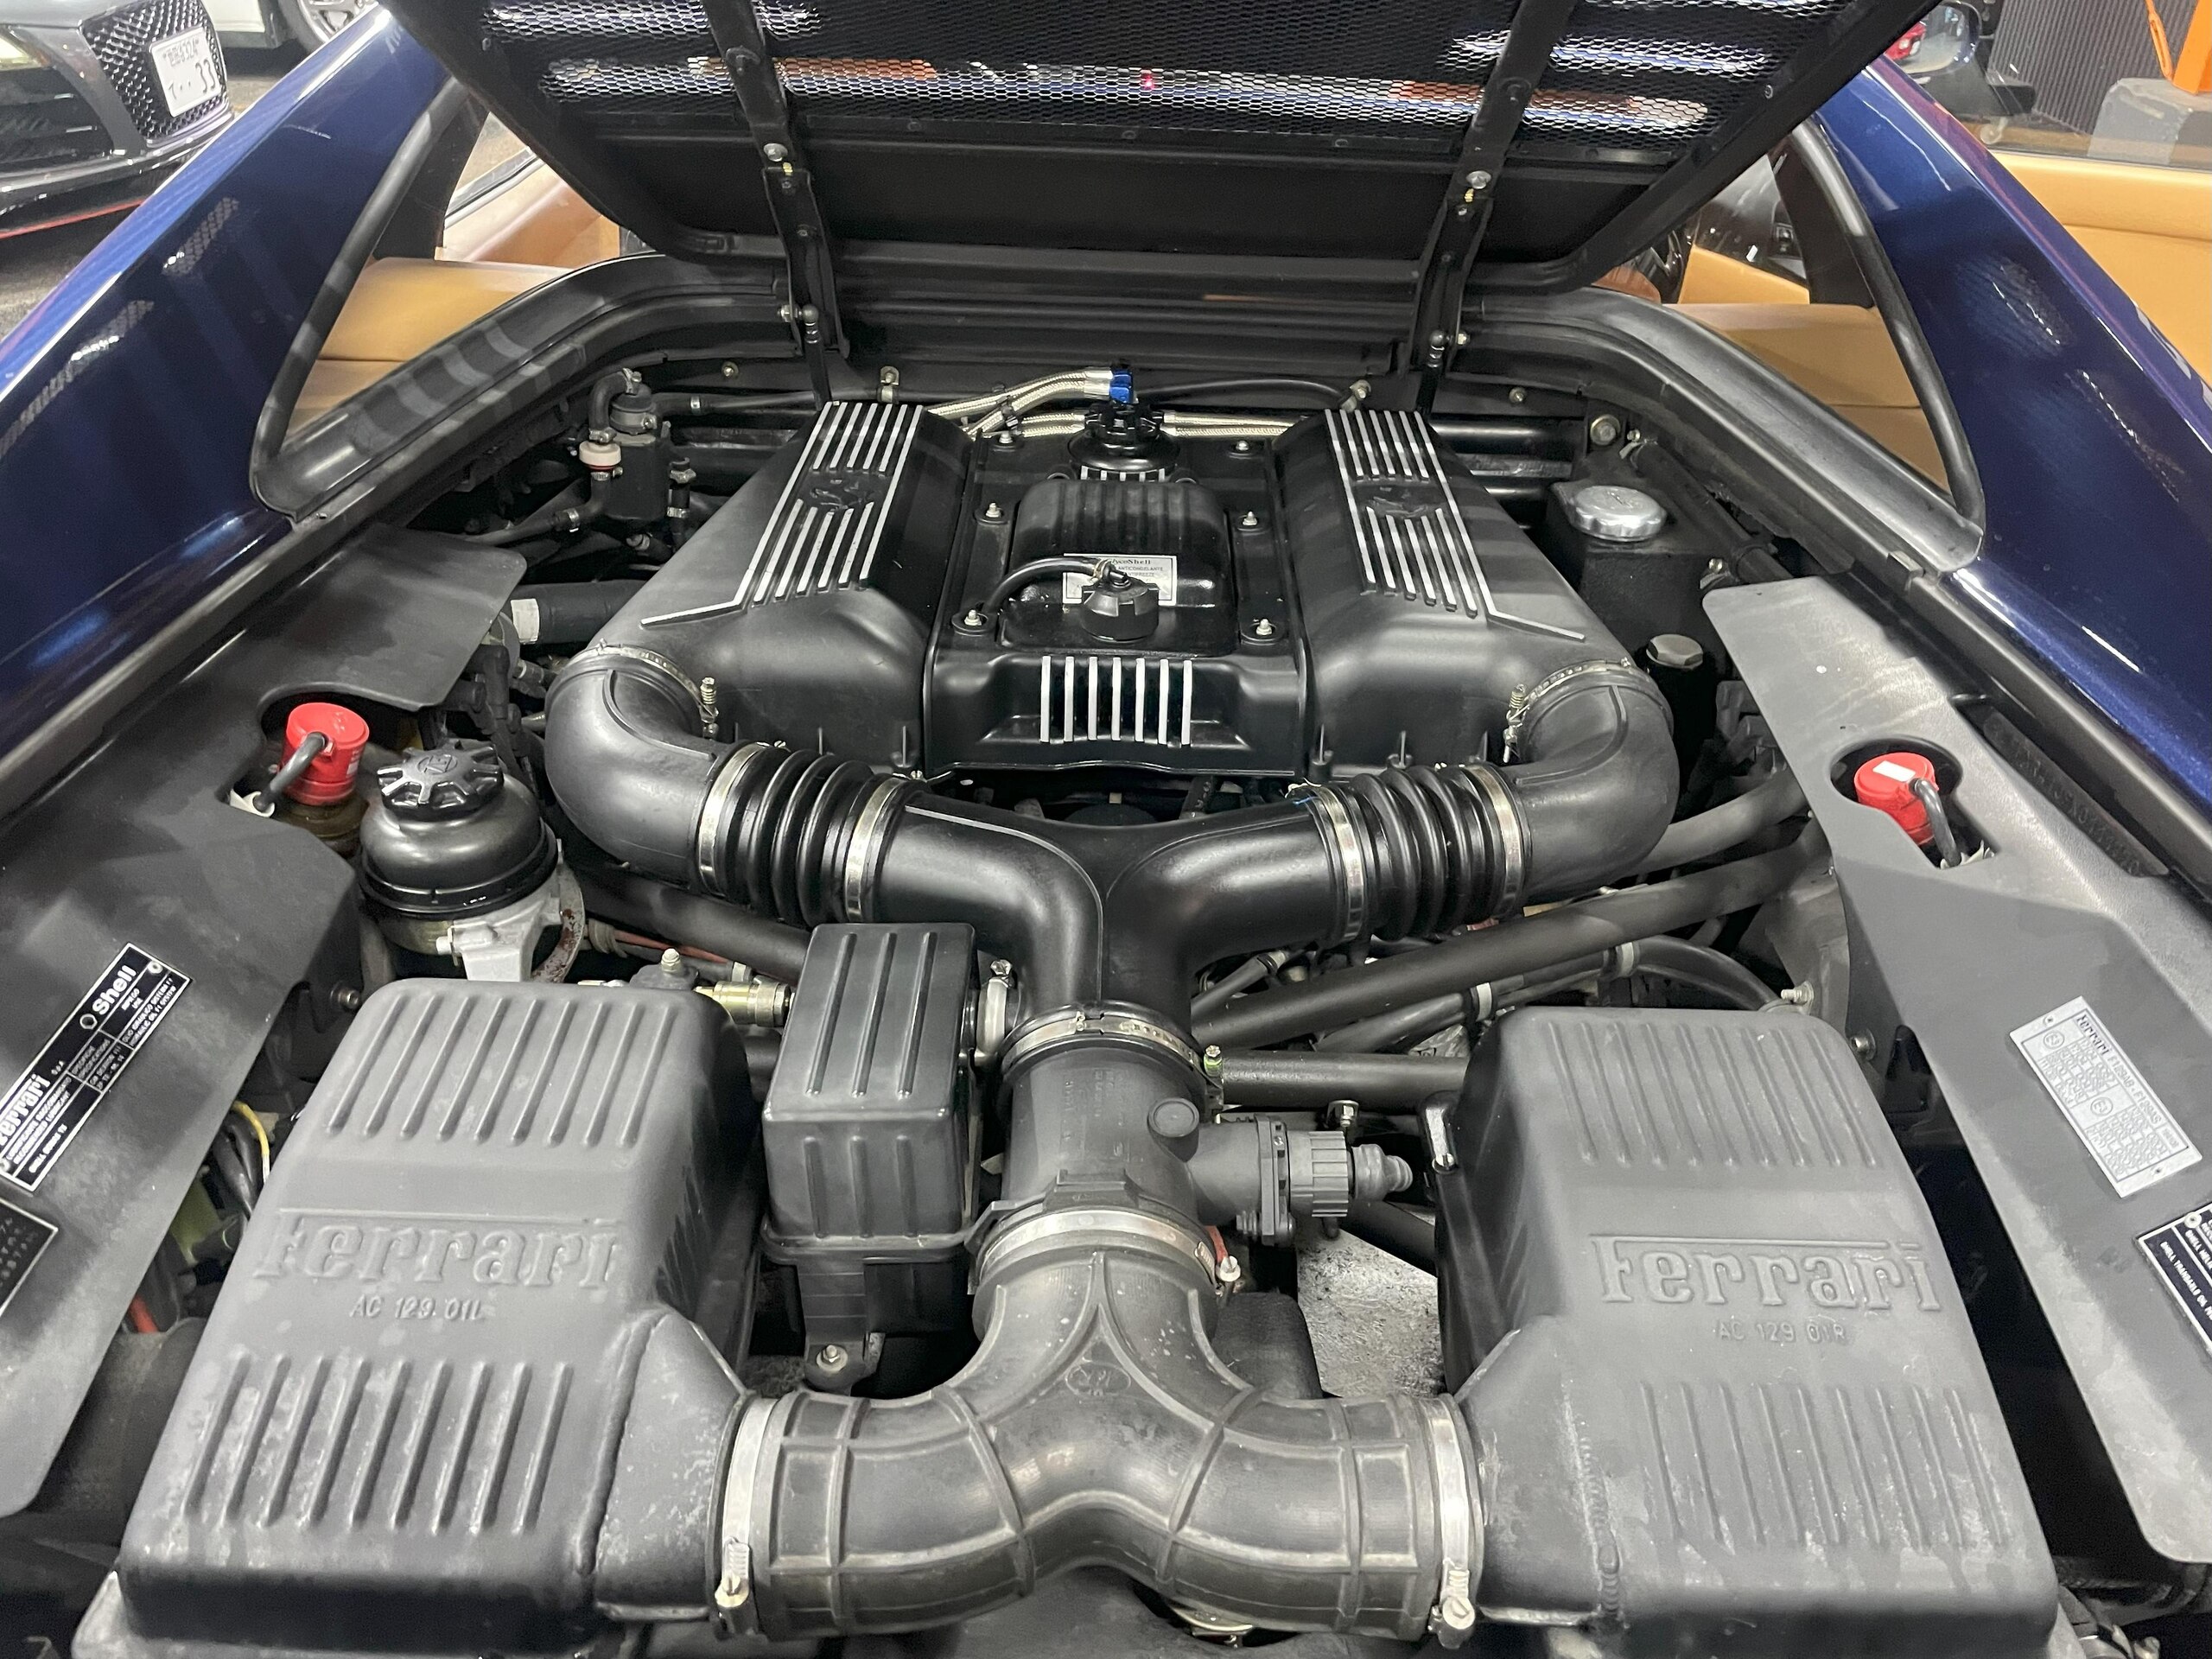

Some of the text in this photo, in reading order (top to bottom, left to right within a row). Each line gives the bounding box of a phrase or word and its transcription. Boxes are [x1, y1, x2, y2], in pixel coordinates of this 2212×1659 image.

[92, 964, 137, 1015] Shell
[2077, 1014, 2110, 1056] Ferrari
[253, 1208, 623, 1287] Ferrari
[1590, 1233, 1942, 1312] Ferrari
[349, 1294, 384, 1318] AC
[1718, 1320, 1745, 1341] AC
[1756, 1320, 1795, 1344] 129
